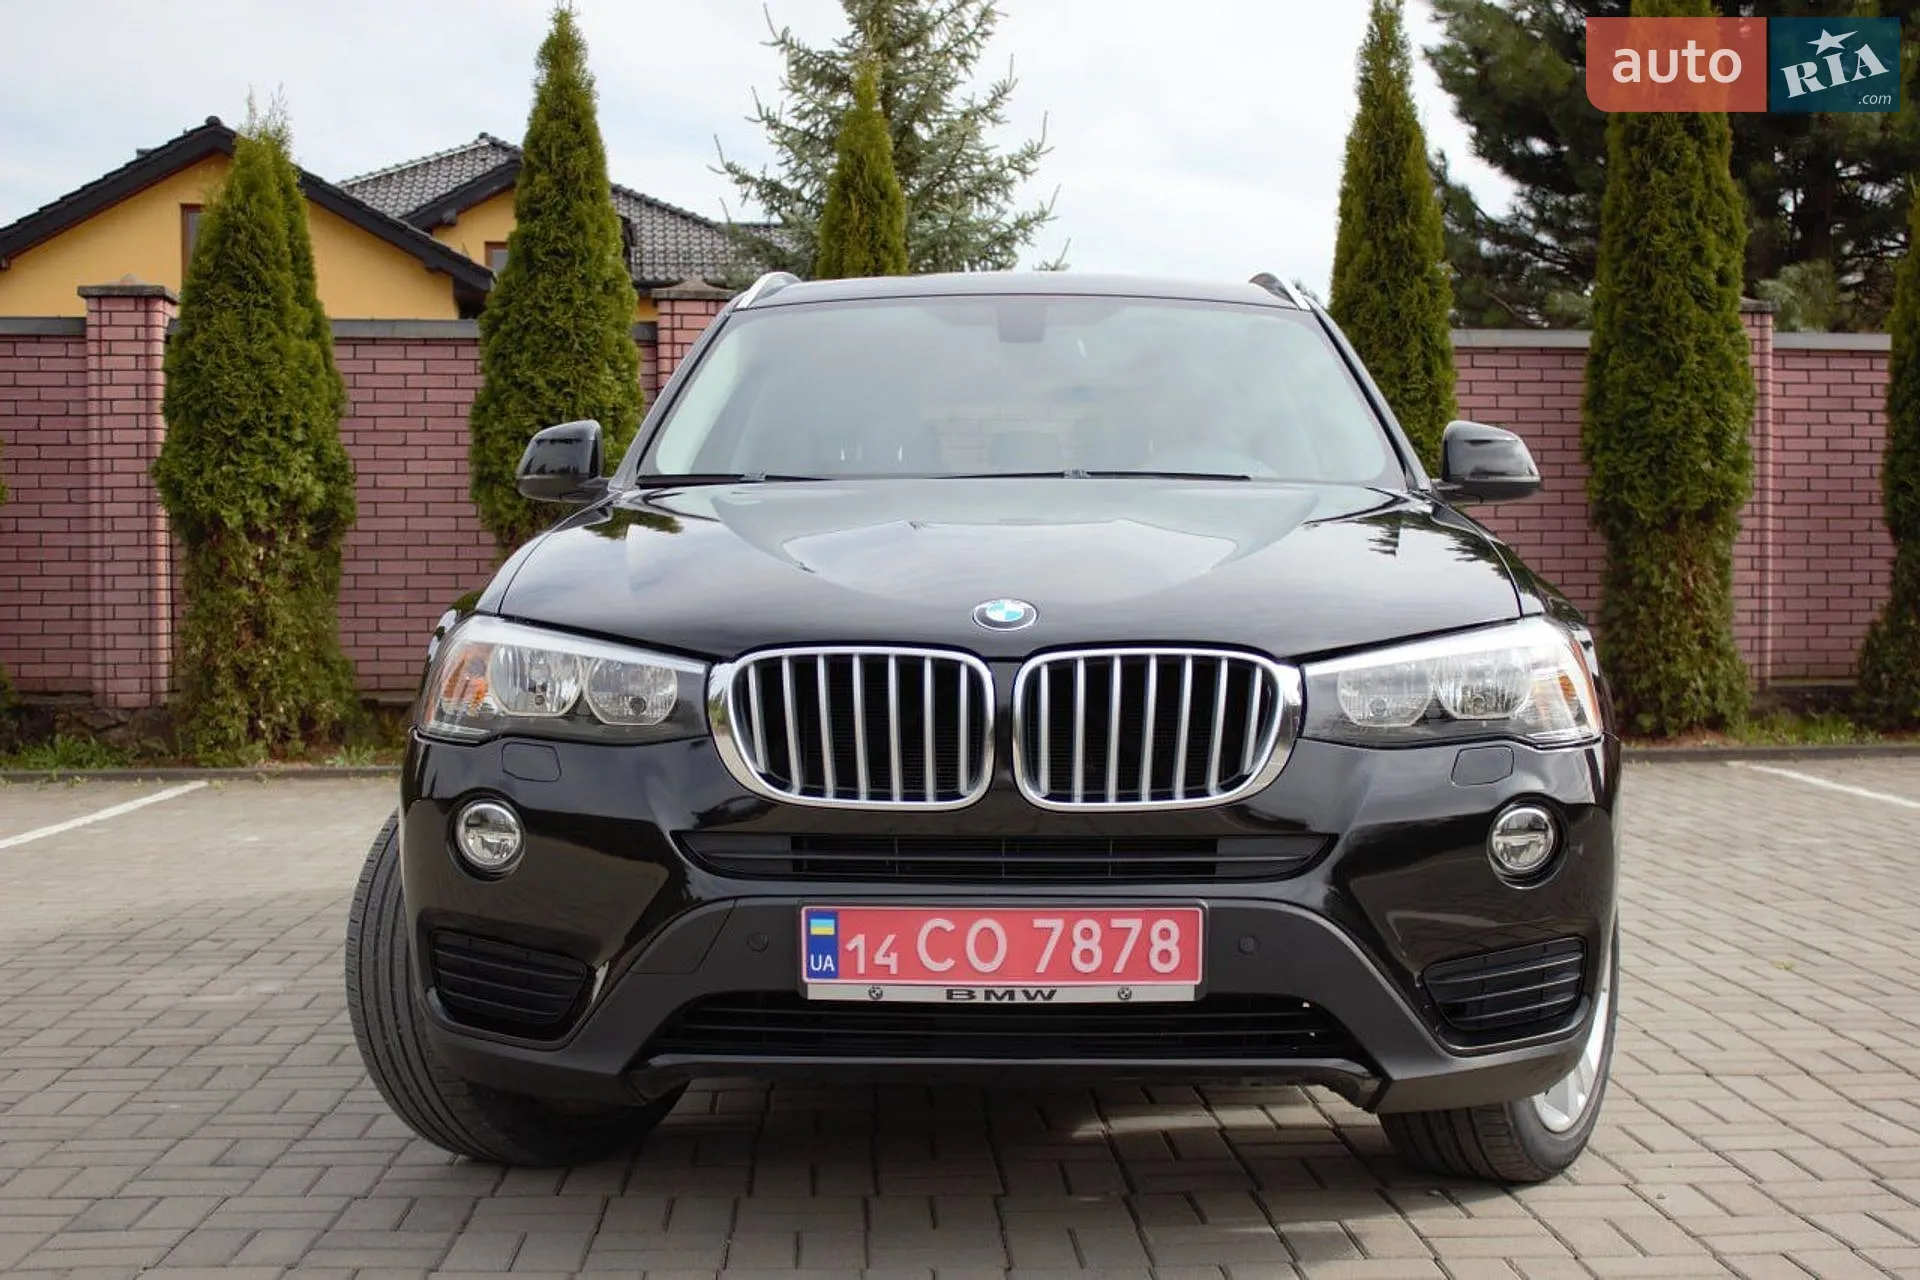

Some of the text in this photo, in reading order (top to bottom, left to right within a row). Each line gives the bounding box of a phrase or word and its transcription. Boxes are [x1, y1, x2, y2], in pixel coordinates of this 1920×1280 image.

[845, 918, 1181, 975] 14 CO 7878
[810, 954, 835, 972] UA
[945, 988, 1057, 1001] BMW
